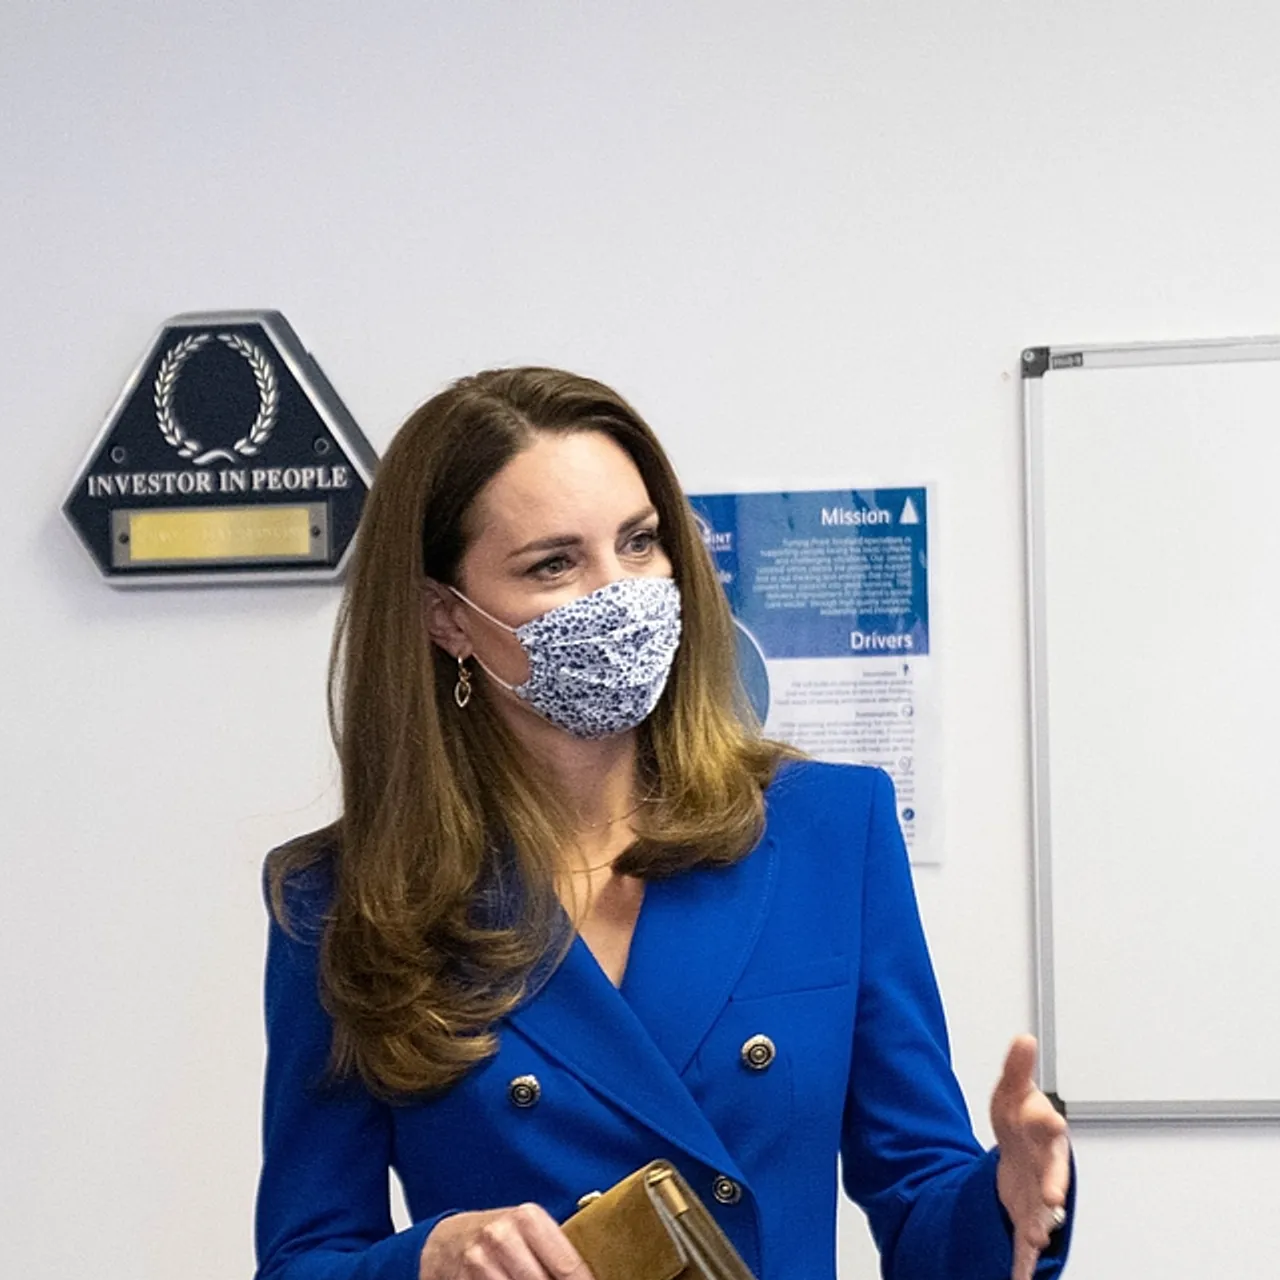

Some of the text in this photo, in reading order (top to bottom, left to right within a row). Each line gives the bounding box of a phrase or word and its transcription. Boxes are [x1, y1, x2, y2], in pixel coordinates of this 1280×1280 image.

[87, 465, 349, 497] INVESTOR IN PEOPLE
[821, 507, 890, 526] Mission
[850, 631, 913, 650] Drivers
